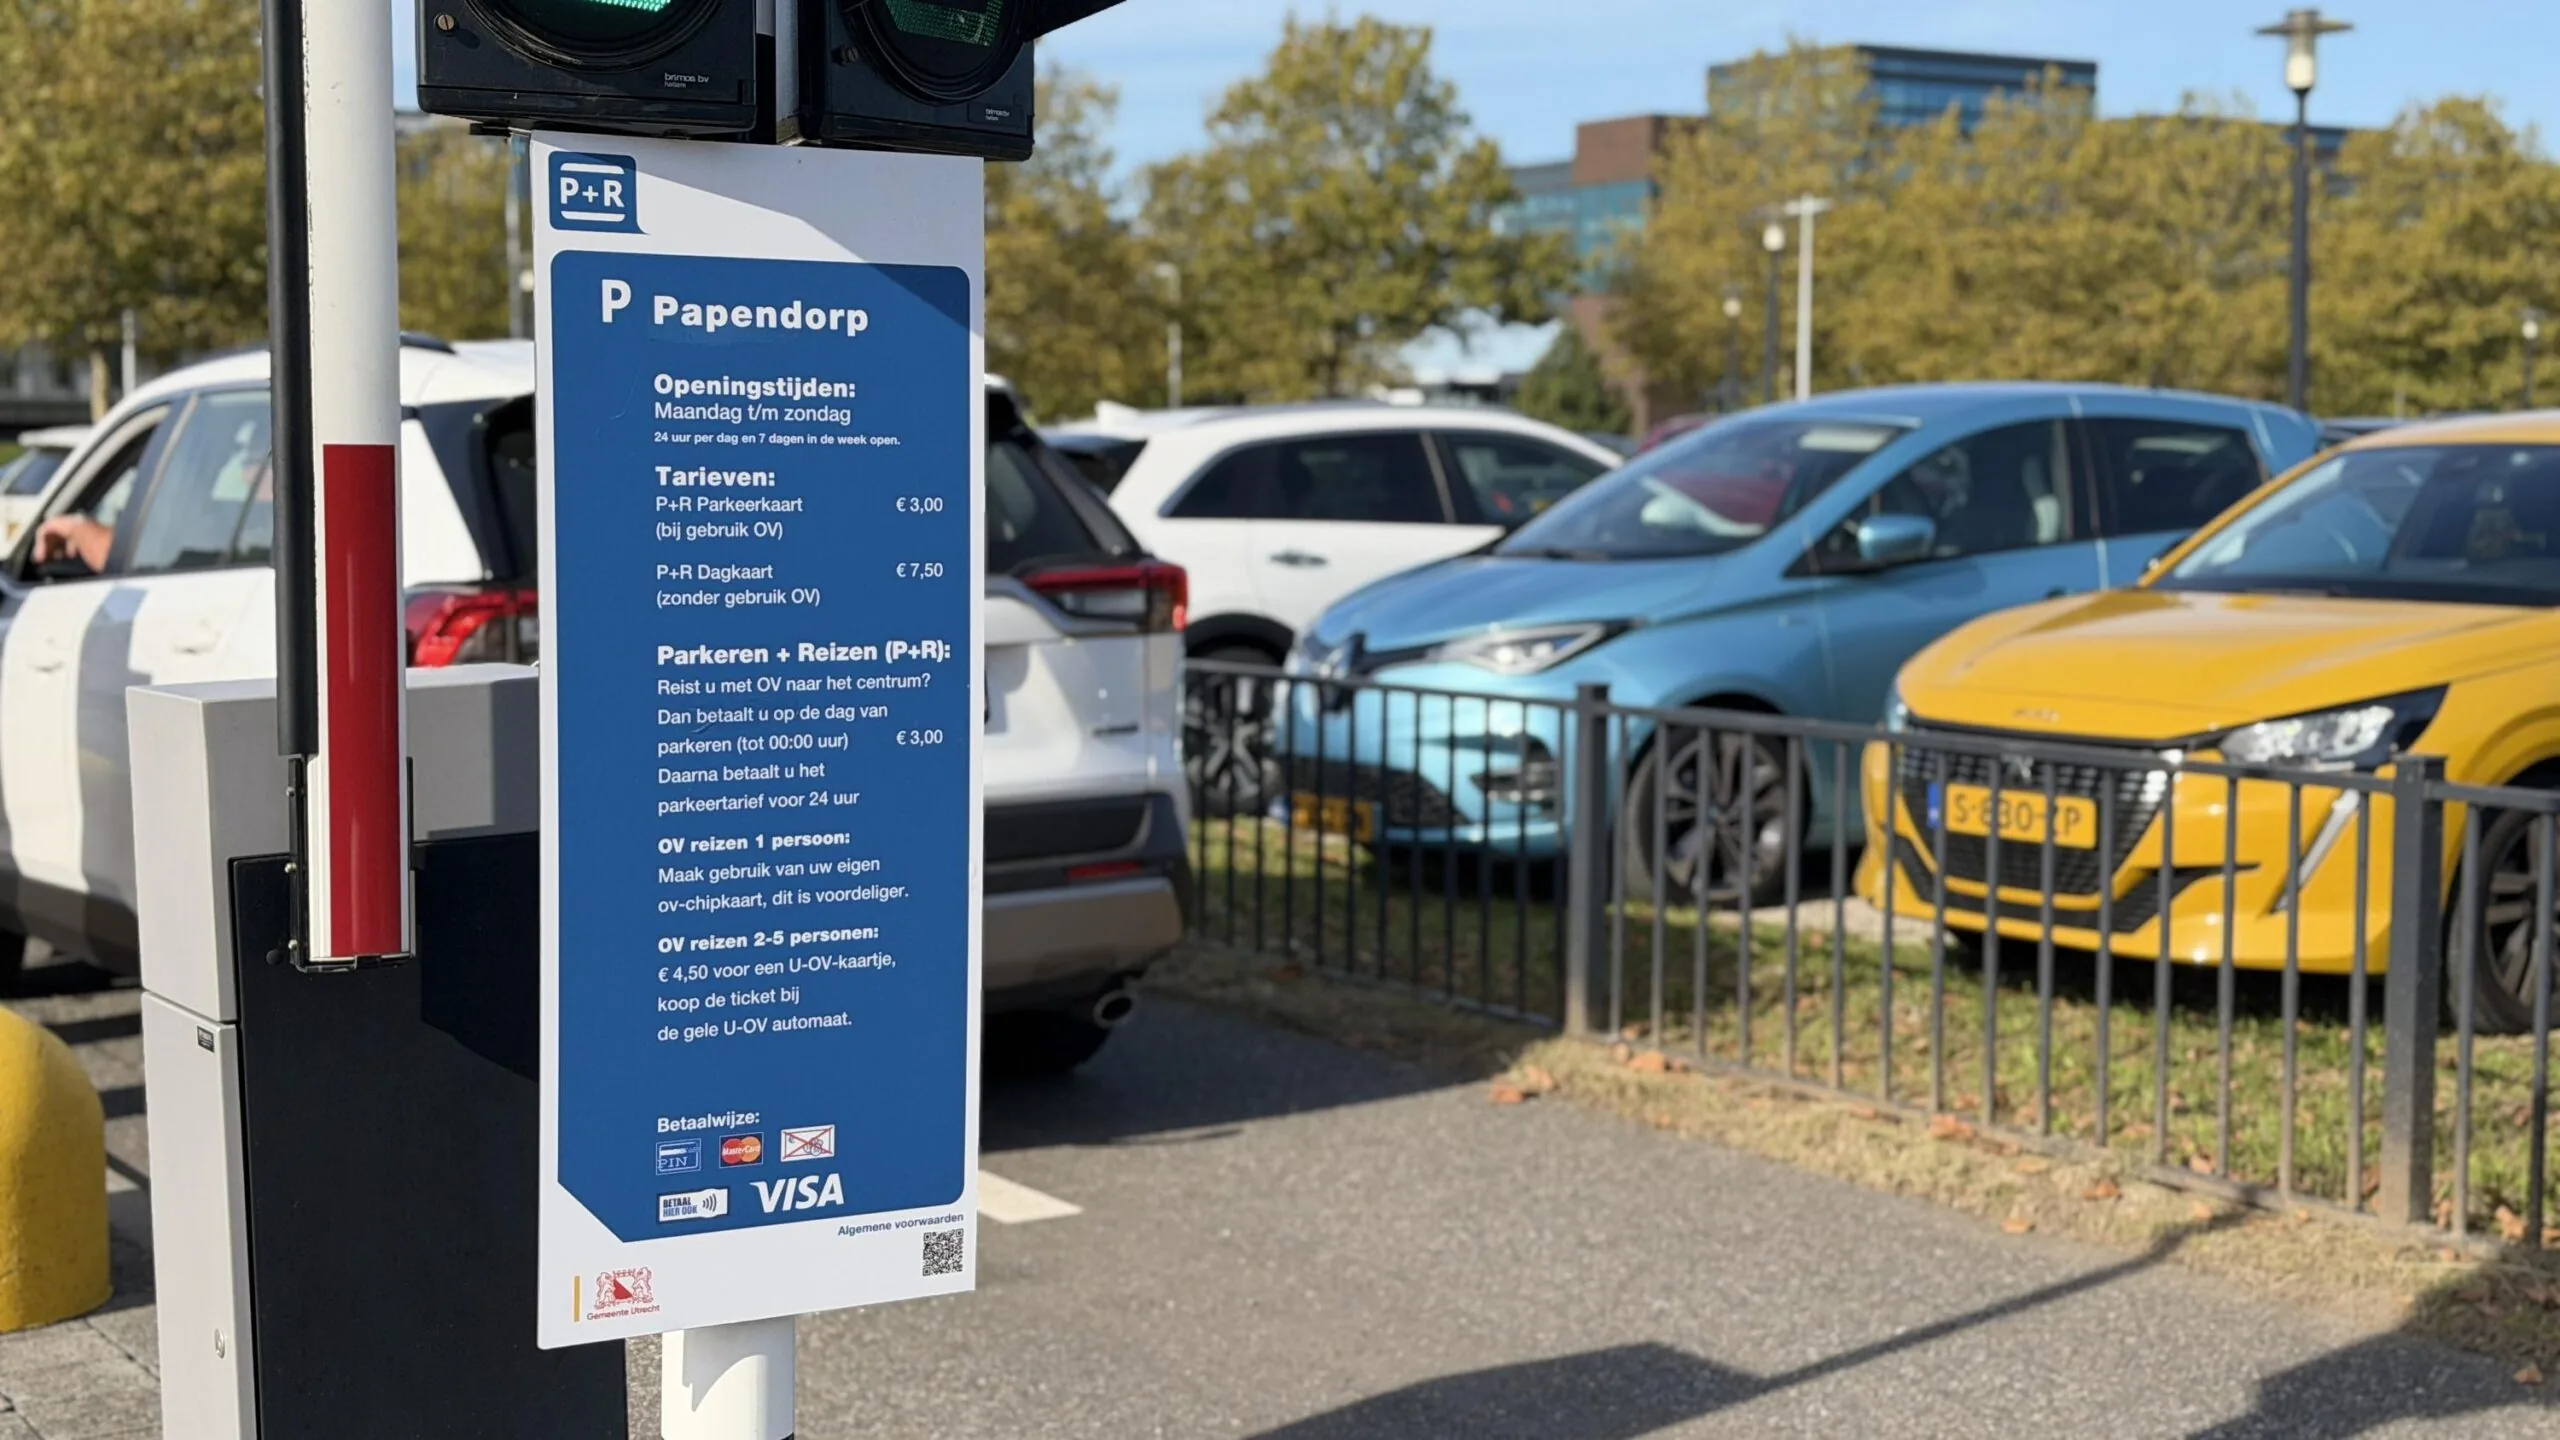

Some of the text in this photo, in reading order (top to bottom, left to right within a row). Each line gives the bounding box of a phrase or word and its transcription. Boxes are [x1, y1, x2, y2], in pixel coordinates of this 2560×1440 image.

[560, 177, 625, 208] P+R
[602, 279, 869, 337] P Papendorp
[653, 373, 856, 401] Openingstijden:
[654, 401, 851, 426] Maandag t/m zondag
[654, 431, 901, 447] 24 uur per dag en 7 dagen in de week open.
[654, 465, 776, 487] Tarieven:
[656, 496, 943, 514] P+R Parkeerkaart € 3,00
[655, 521, 783, 541] (bij gebruik OV)
[656, 562, 944, 583] P+R Dagkaart € 7,50
[656, 588, 821, 609] (zonder gebruik OV)
[657, 639, 951, 666] Parkeren + Reizen (P+R):
[657, 672, 931, 695] Reist u met OV naar het centrum?
[657, 704, 888, 725] Dan betaalt u op de dag van
[657, 729, 943, 758] parkeren (tot 00:00 uur) € 3,00
[658, 762, 825, 784] Daarna betaalt u het
[658, 790, 860, 817] parkeertarief voor 24 uur
[657, 832, 850, 854] OV reizen 1 persoon:
[658, 857, 880, 884] Maak gebruik van uw eigen
[658, 884, 909, 913] ov-chipkaart, dit is voordeliger.
[657, 927, 879, 954] OV reizen 2-5 personen:
[658, 951, 896, 983] € 4,50 voor een U-OV-kaartje,
[657, 986, 800, 1013] koop de ticket bij
[657, 1011, 852, 1043] de gele U-OV automaat.
[657, 1110, 760, 1133] Betaalwijze:
[722, 1144, 761, 1156] MasterCard
[658, 1156, 689, 1168] PIN
[663, 1197, 691, 1208] BETAAL
[749, 1172, 845, 1213] VISA
[663, 1205, 697, 1217] HIER OOK
[837, 1213, 964, 1237] Algemene voorwaarden
[587, 1304, 660, 1321] Gemeente Utrecht
